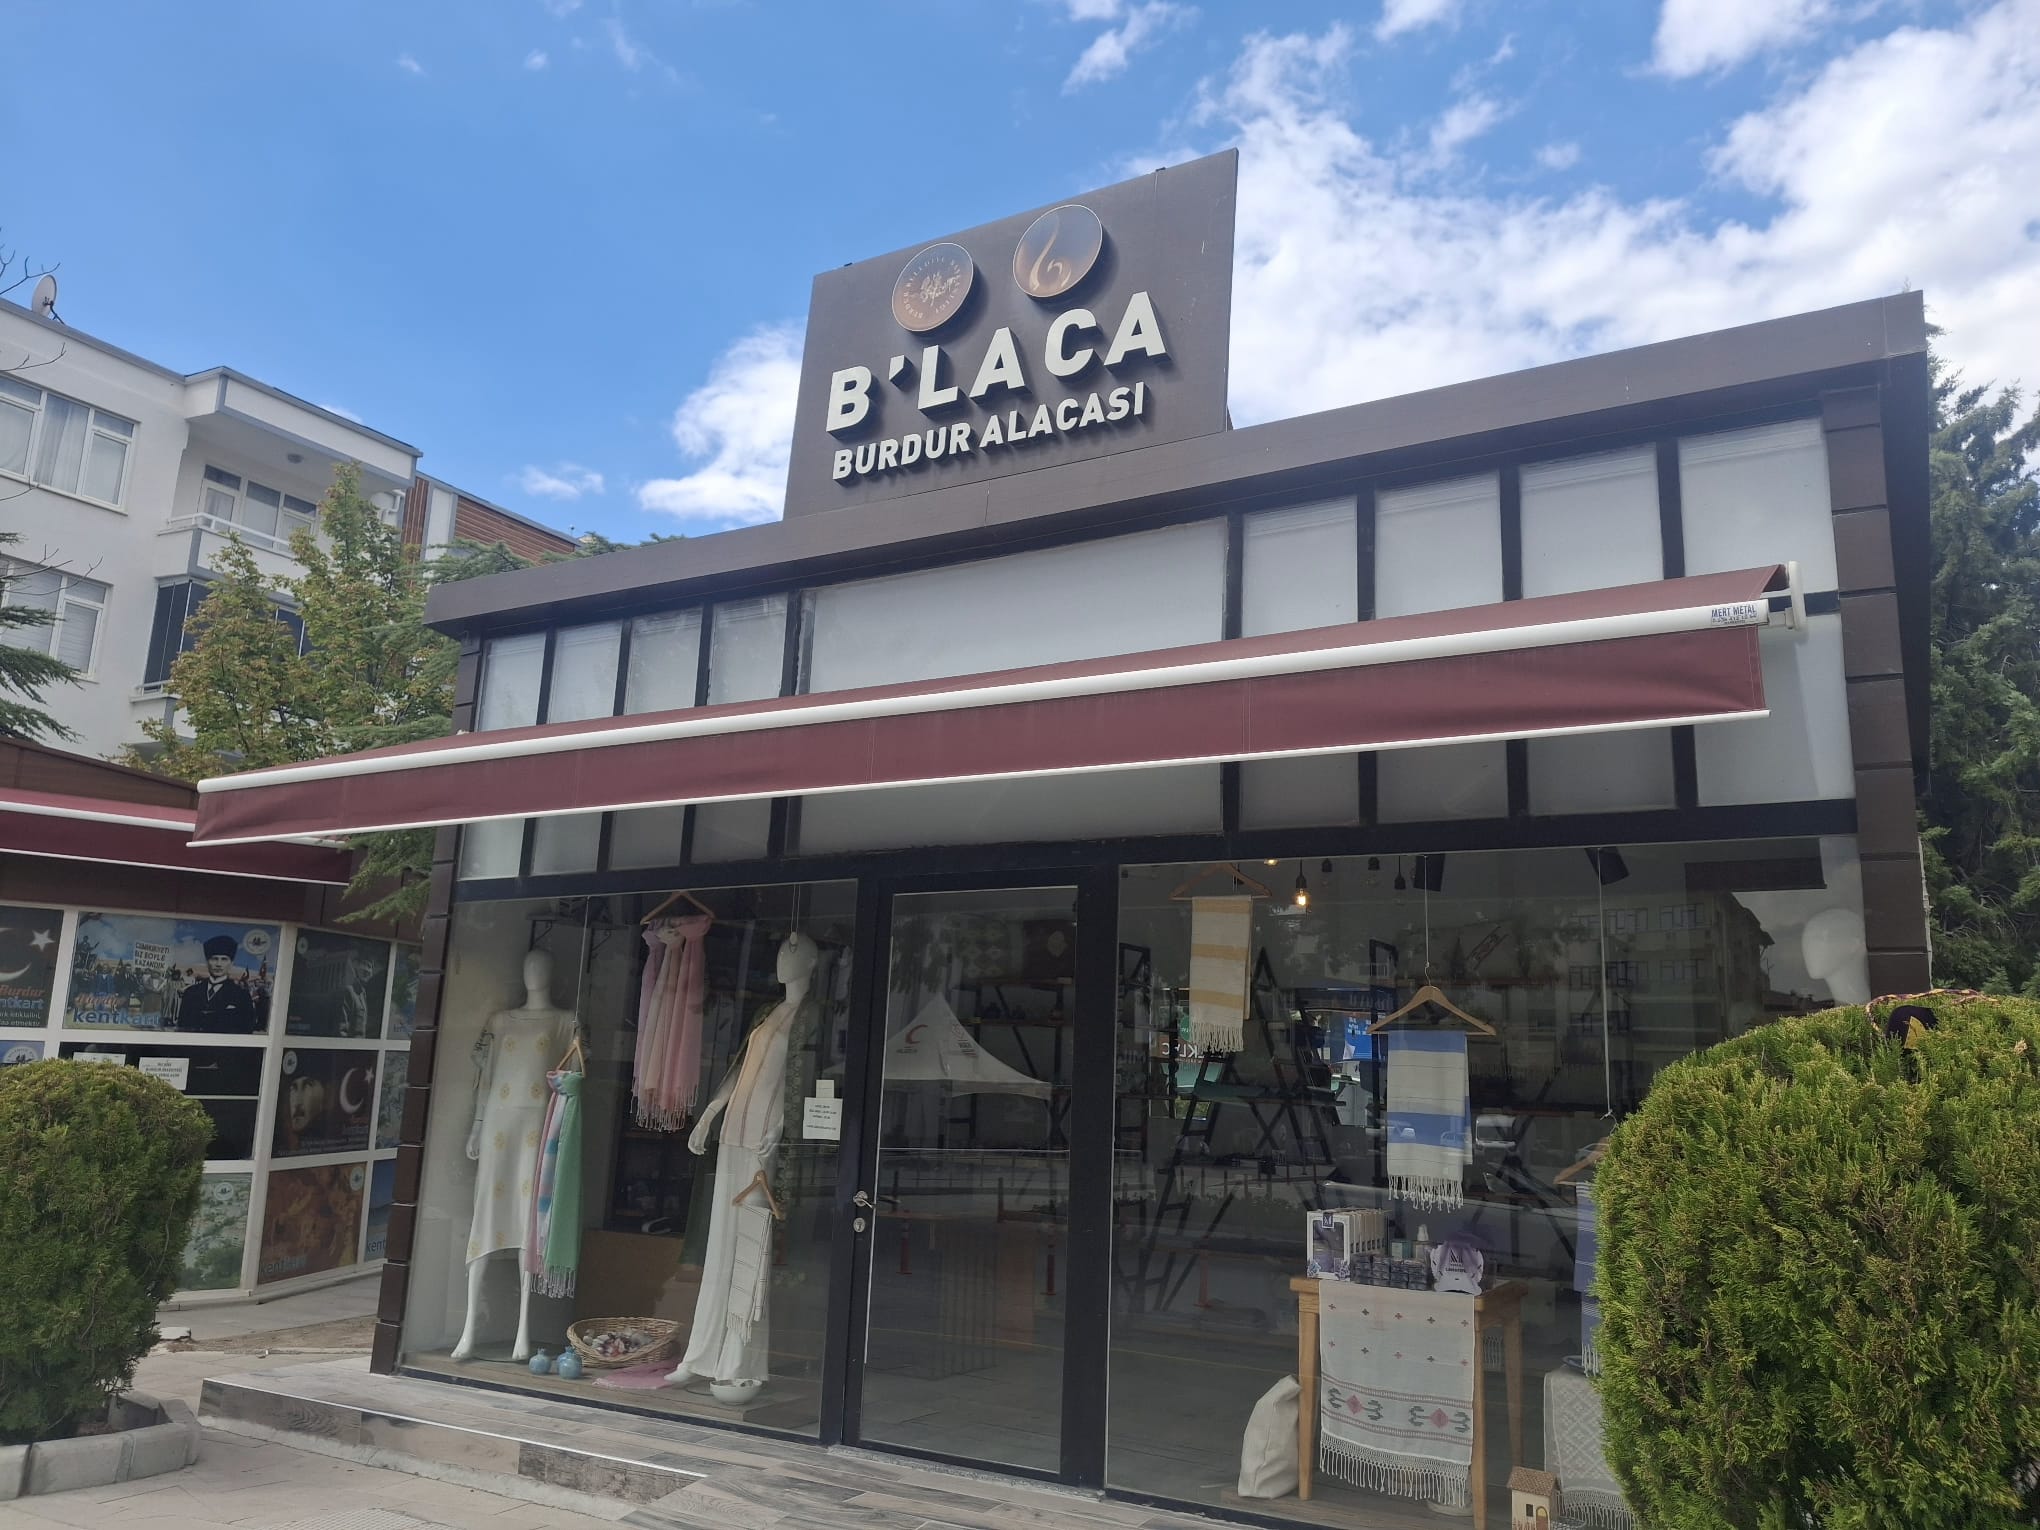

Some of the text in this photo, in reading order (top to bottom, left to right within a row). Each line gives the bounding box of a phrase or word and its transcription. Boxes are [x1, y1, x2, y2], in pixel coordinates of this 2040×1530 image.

[833, 381, 1145, 480] BURDUR ALACASI
[1712, 607, 1730, 618] MERT
[1732, 604, 1756, 616] METAL
